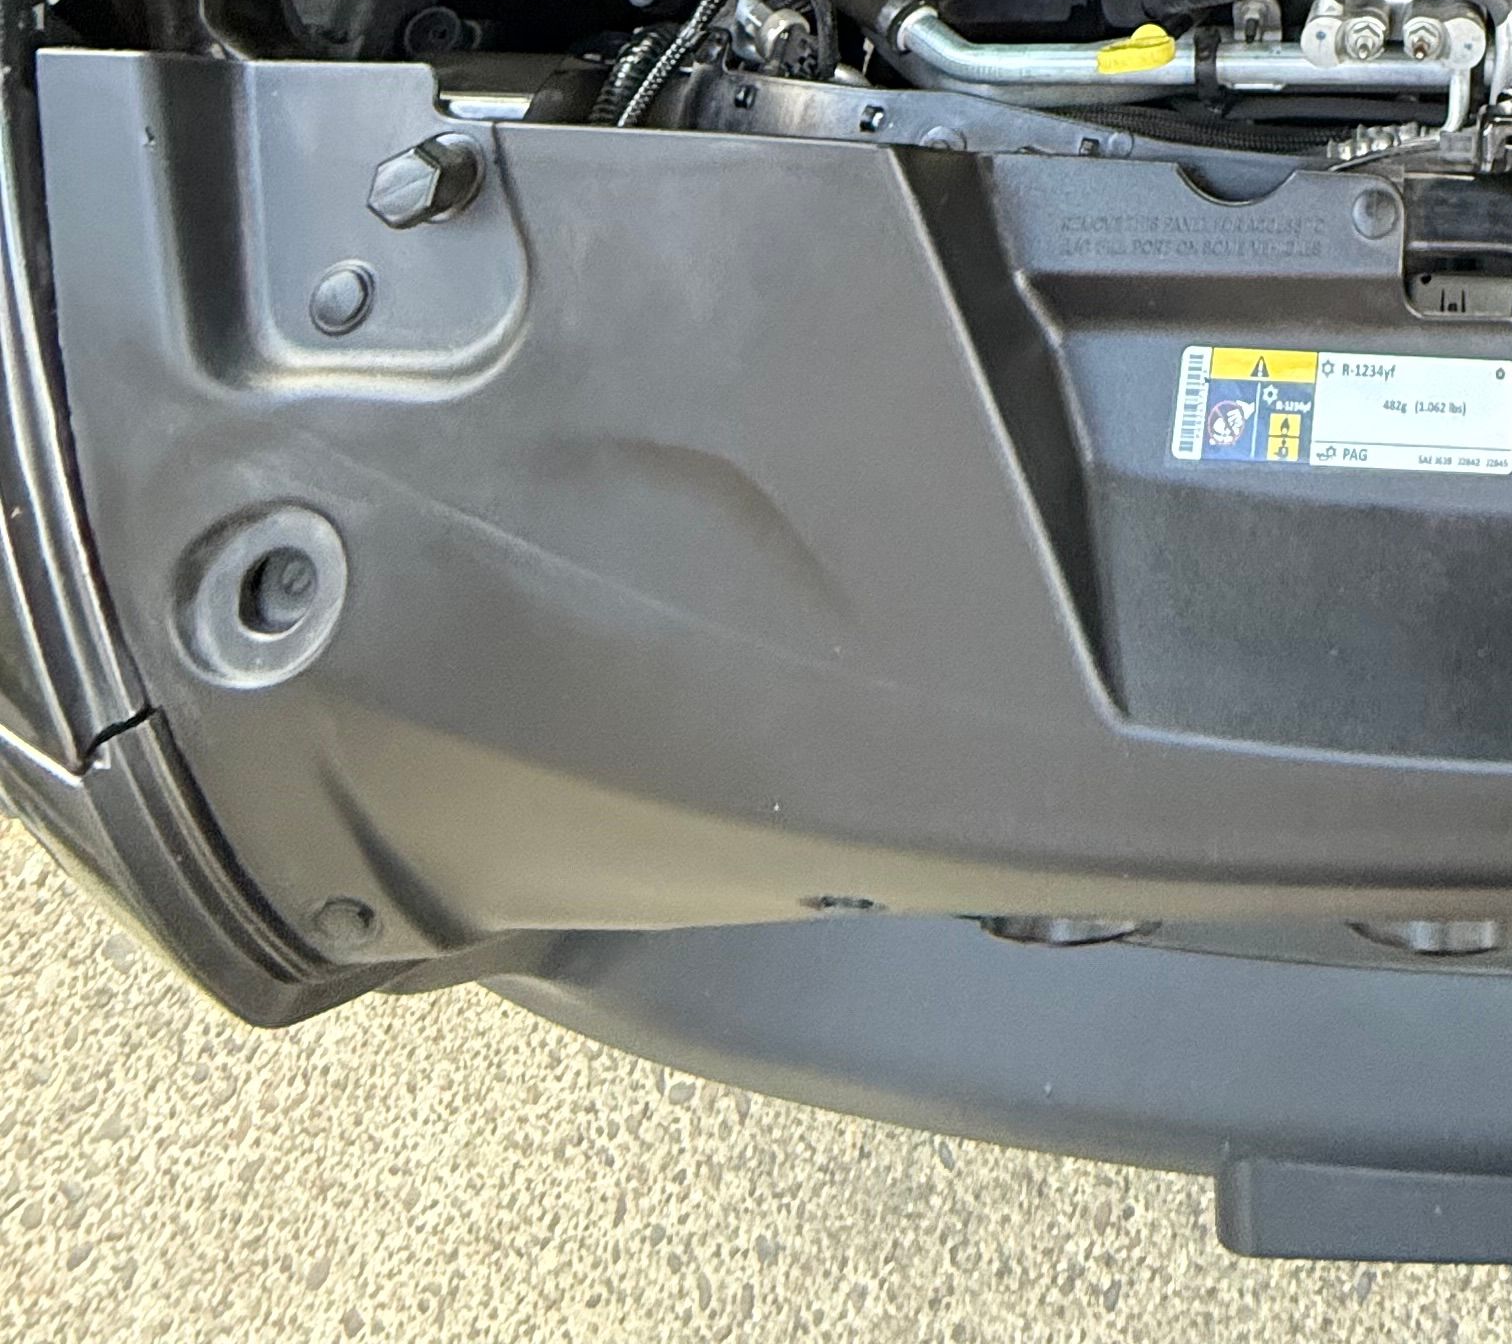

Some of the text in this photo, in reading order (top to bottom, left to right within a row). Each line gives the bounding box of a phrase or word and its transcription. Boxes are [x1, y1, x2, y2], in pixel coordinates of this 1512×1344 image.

[1342, 363, 1396, 382] R-1234yf
[1383, 399, 1467, 416] 482g (1.062 lbs)
[1342, 448, 1368, 462] PAG
